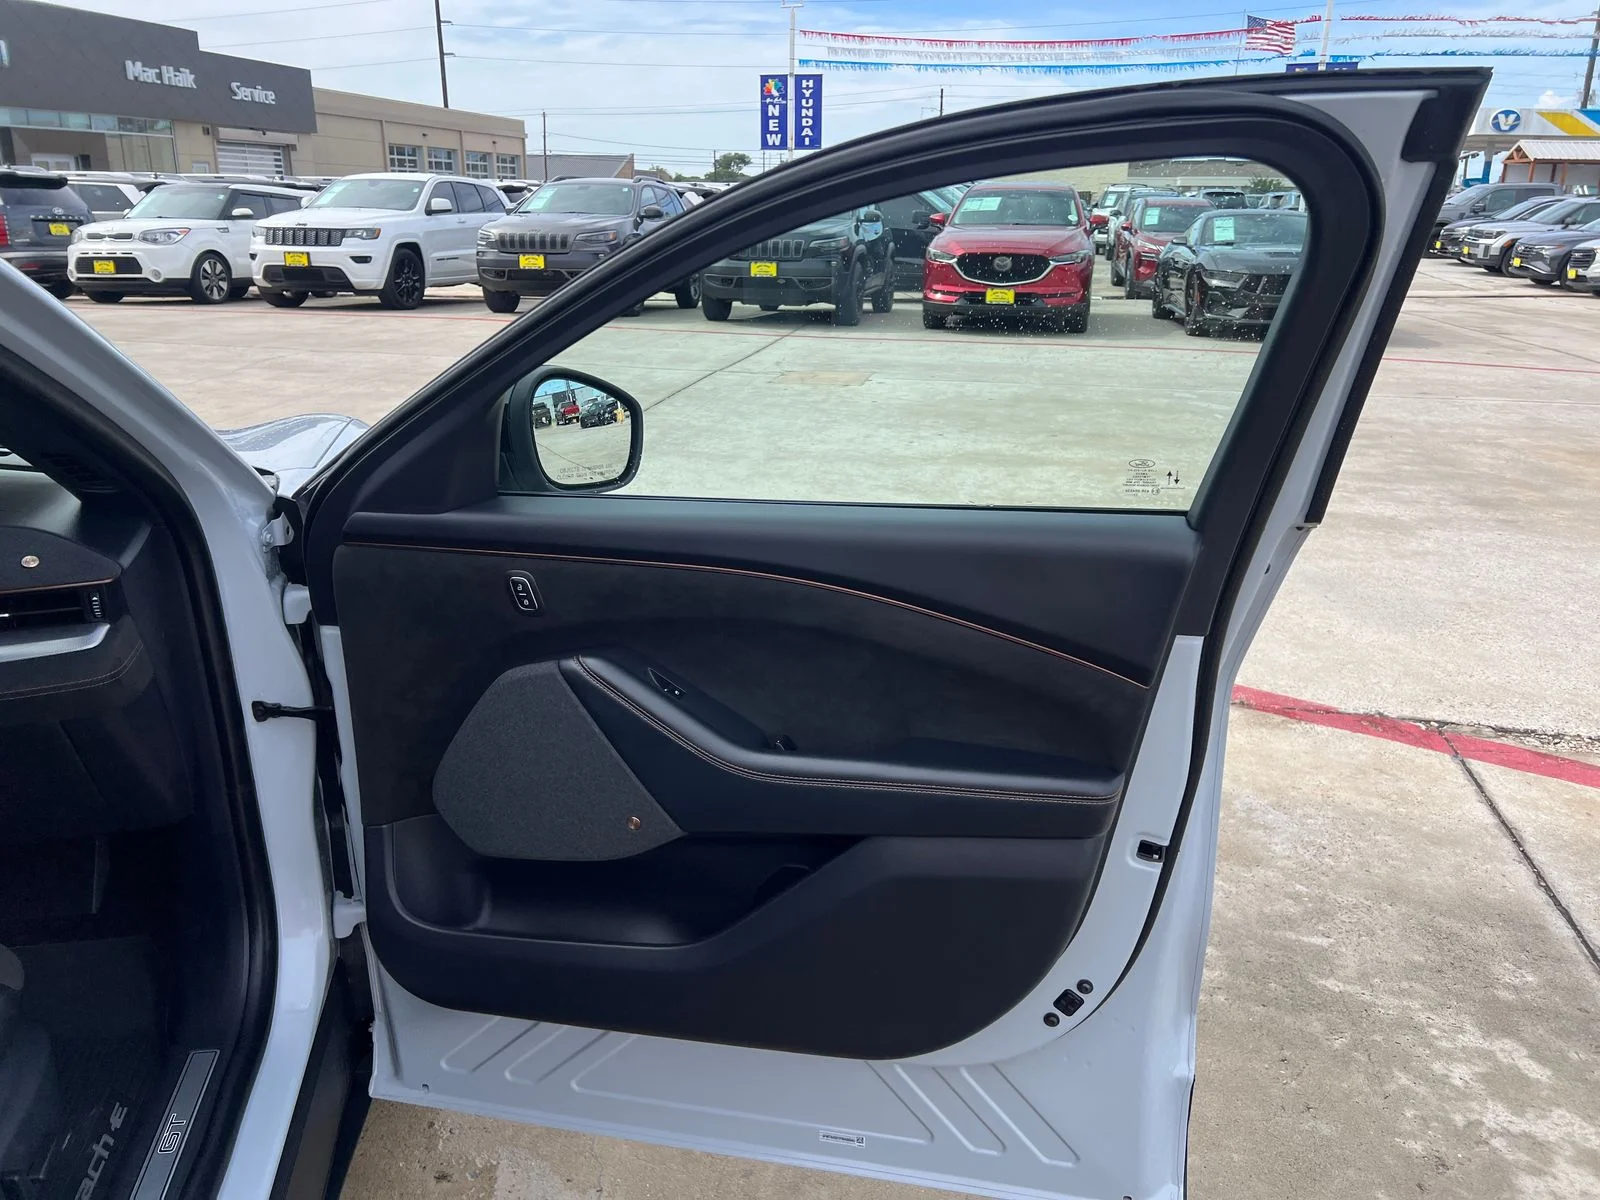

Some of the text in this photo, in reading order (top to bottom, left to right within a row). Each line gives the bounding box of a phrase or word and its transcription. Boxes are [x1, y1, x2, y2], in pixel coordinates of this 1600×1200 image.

[125, 60, 197, 89] Mac Haik
[231, 82, 276, 105] Service
[766, 104, 782, 146] NEW
[801, 79, 814, 146] HYUNDAI
[157, 1113, 187, 1154] GT
